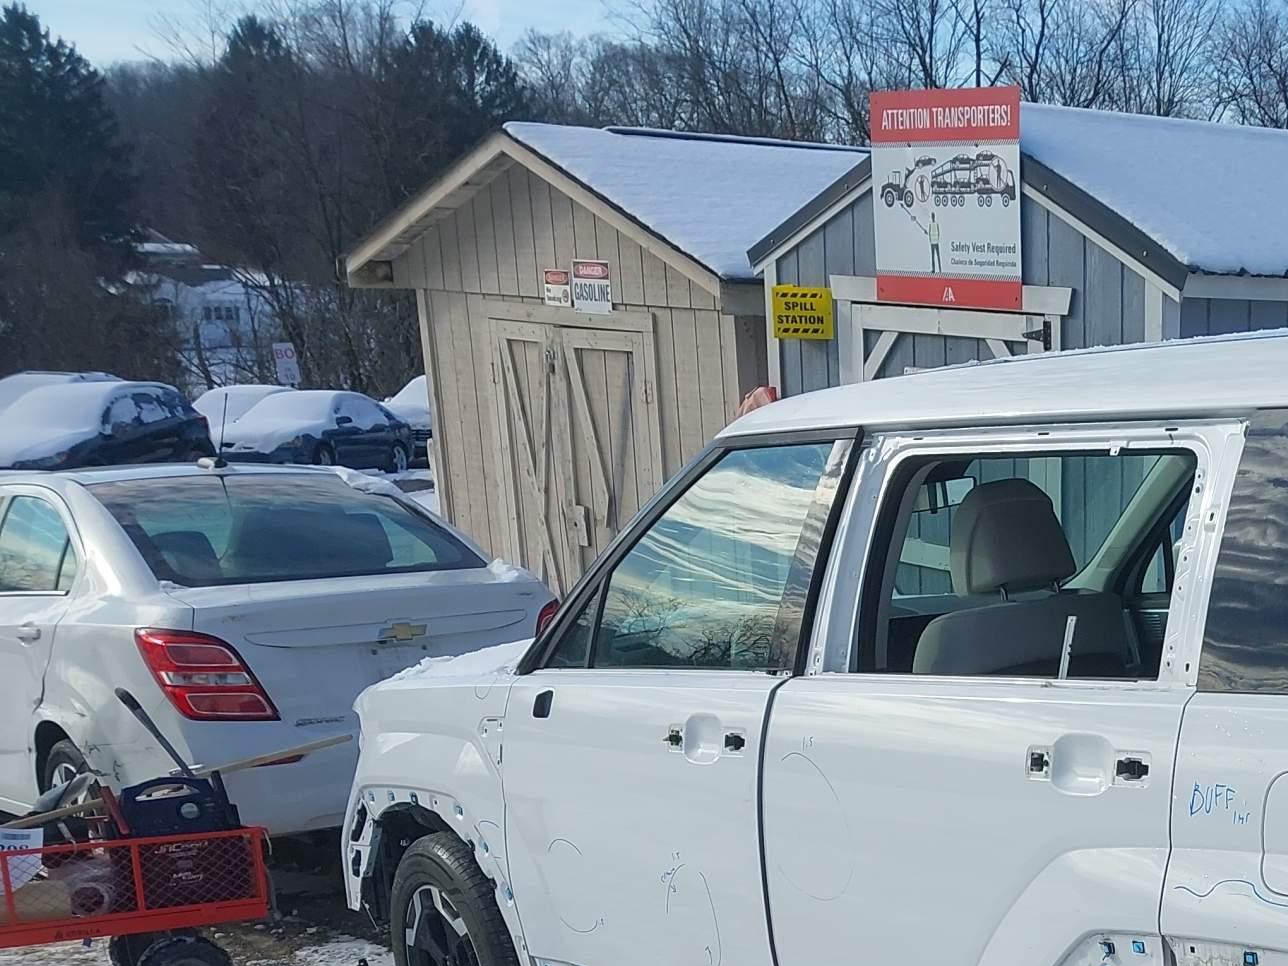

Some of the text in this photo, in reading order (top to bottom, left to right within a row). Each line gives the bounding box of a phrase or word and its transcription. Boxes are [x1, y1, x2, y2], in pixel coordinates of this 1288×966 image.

[881, 104, 1011, 130] ATTENTION TRANSPORTERS!
[951, 241, 1016, 255] Safety Vest Required
[575, 283, 610, 302] GASOLINE
[784, 301, 817, 312] SPILL
[777, 314, 825, 326] STATION
